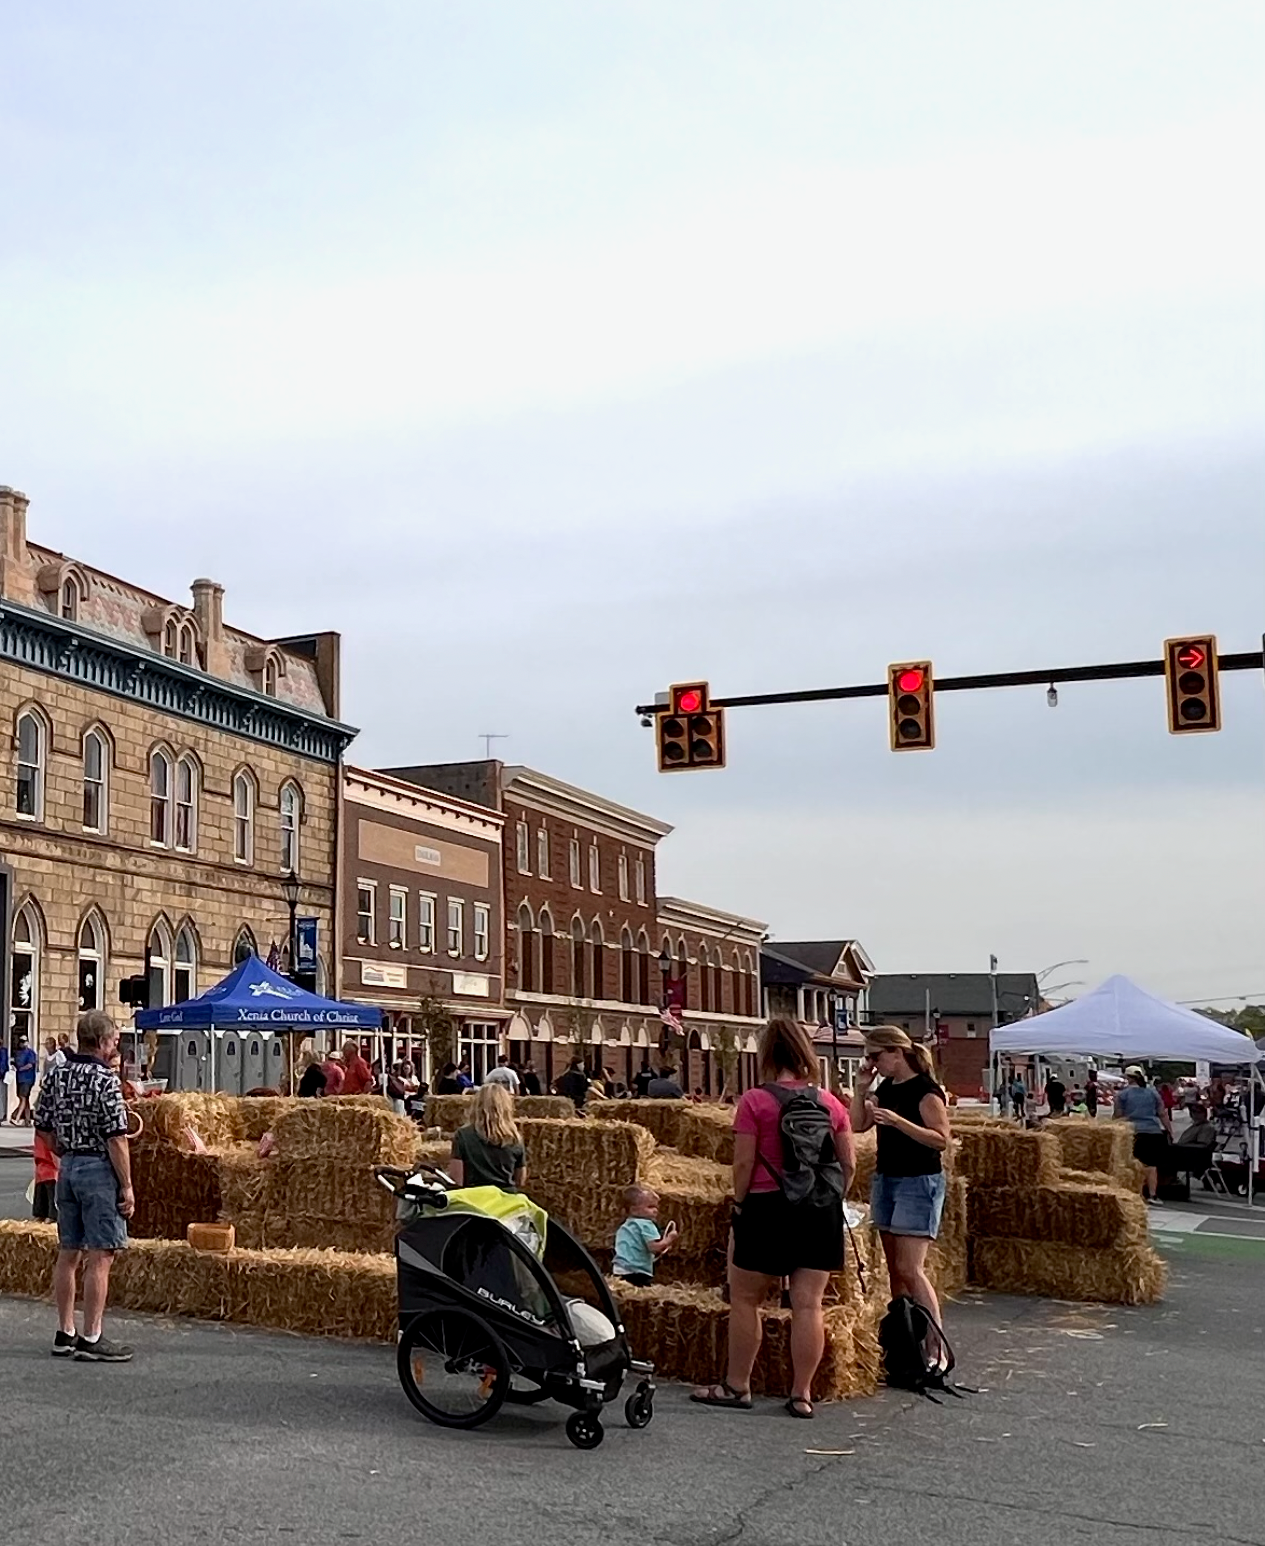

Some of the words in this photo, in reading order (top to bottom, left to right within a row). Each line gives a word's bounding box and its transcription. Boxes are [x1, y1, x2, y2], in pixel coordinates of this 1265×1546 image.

[237, 1008, 268, 1021] Xenia
[271, 1009, 311, 1021] Church
[312, 1009, 326, 1023] of
[326, 1010, 361, 1024] Christ
[477, 1287, 546, 1326] BURLEY
